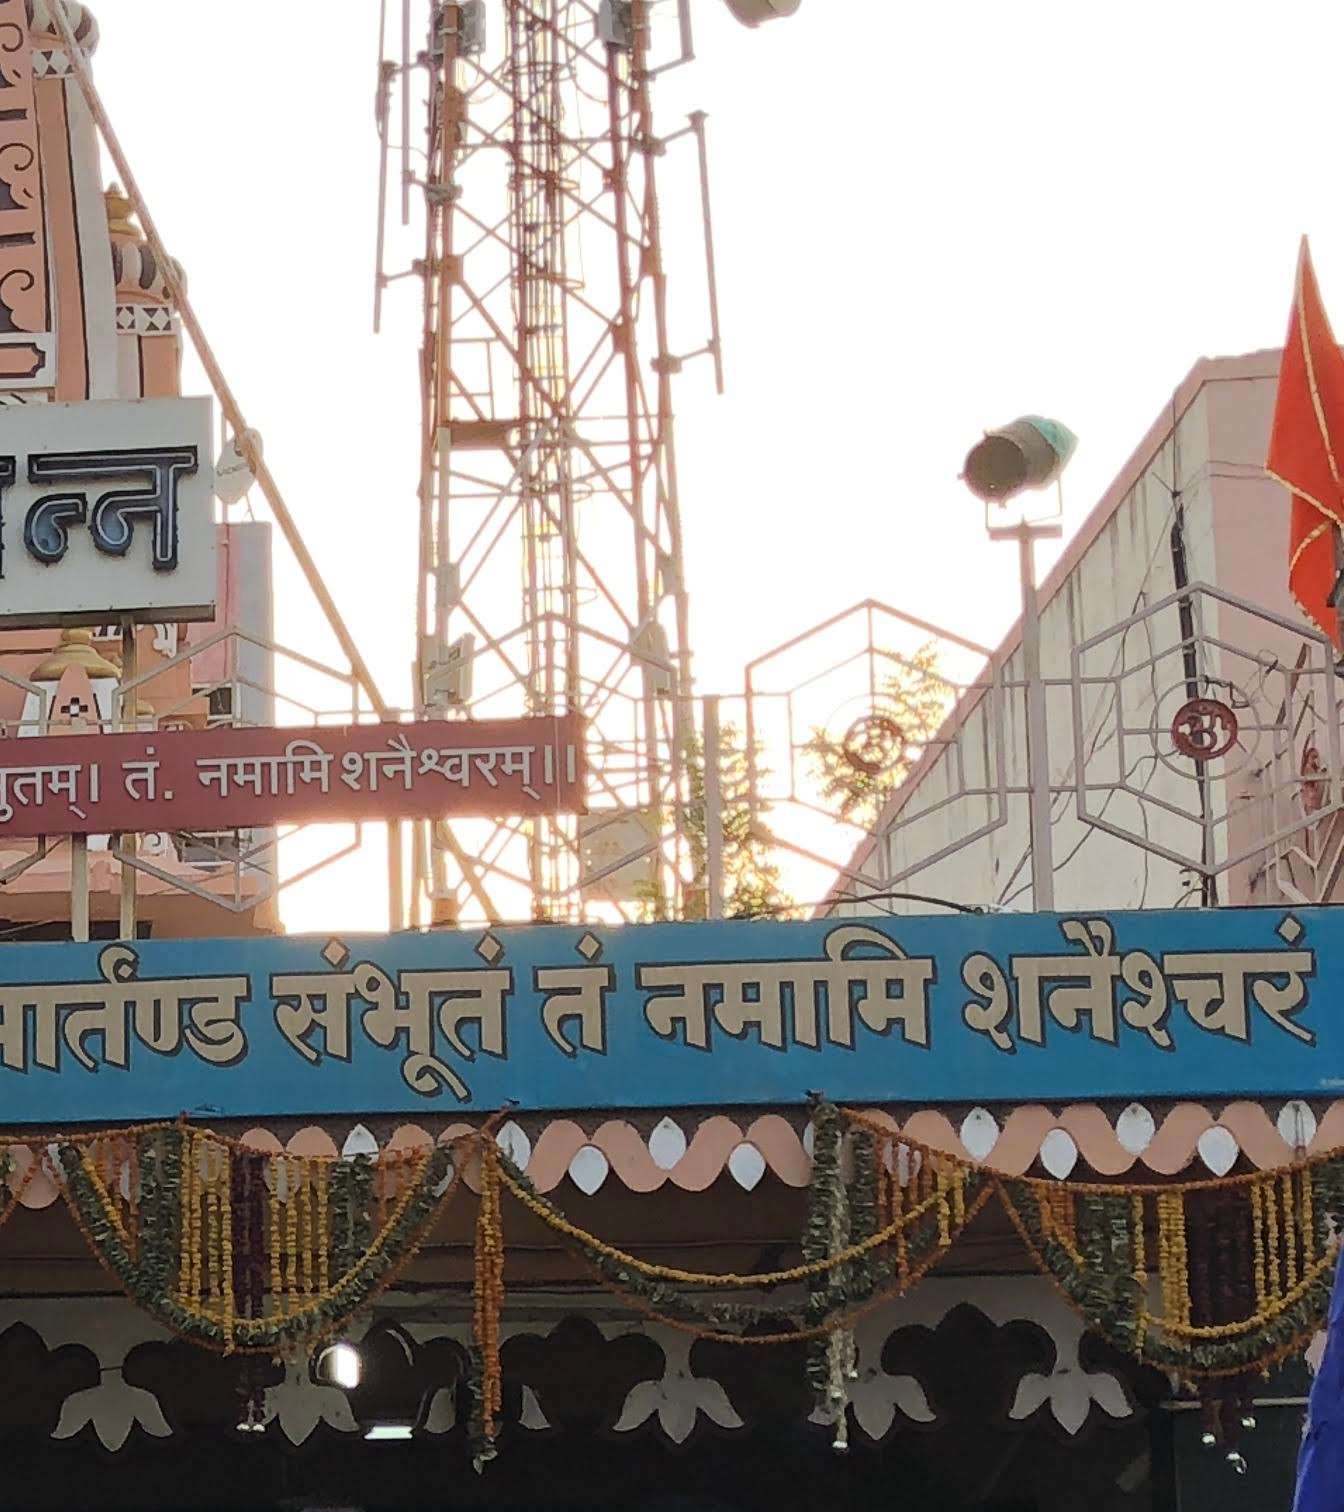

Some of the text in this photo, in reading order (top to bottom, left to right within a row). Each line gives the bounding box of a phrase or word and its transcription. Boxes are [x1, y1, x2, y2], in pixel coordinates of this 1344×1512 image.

[197, 741, 333, 797] नमामि
[269, 931, 513, 1103] संभूतं
[533, 931, 616, 1058] तं
[636, 923, 936, 1051] नमामि
[960, 912, 1318, 1055] शनैश्चरं
